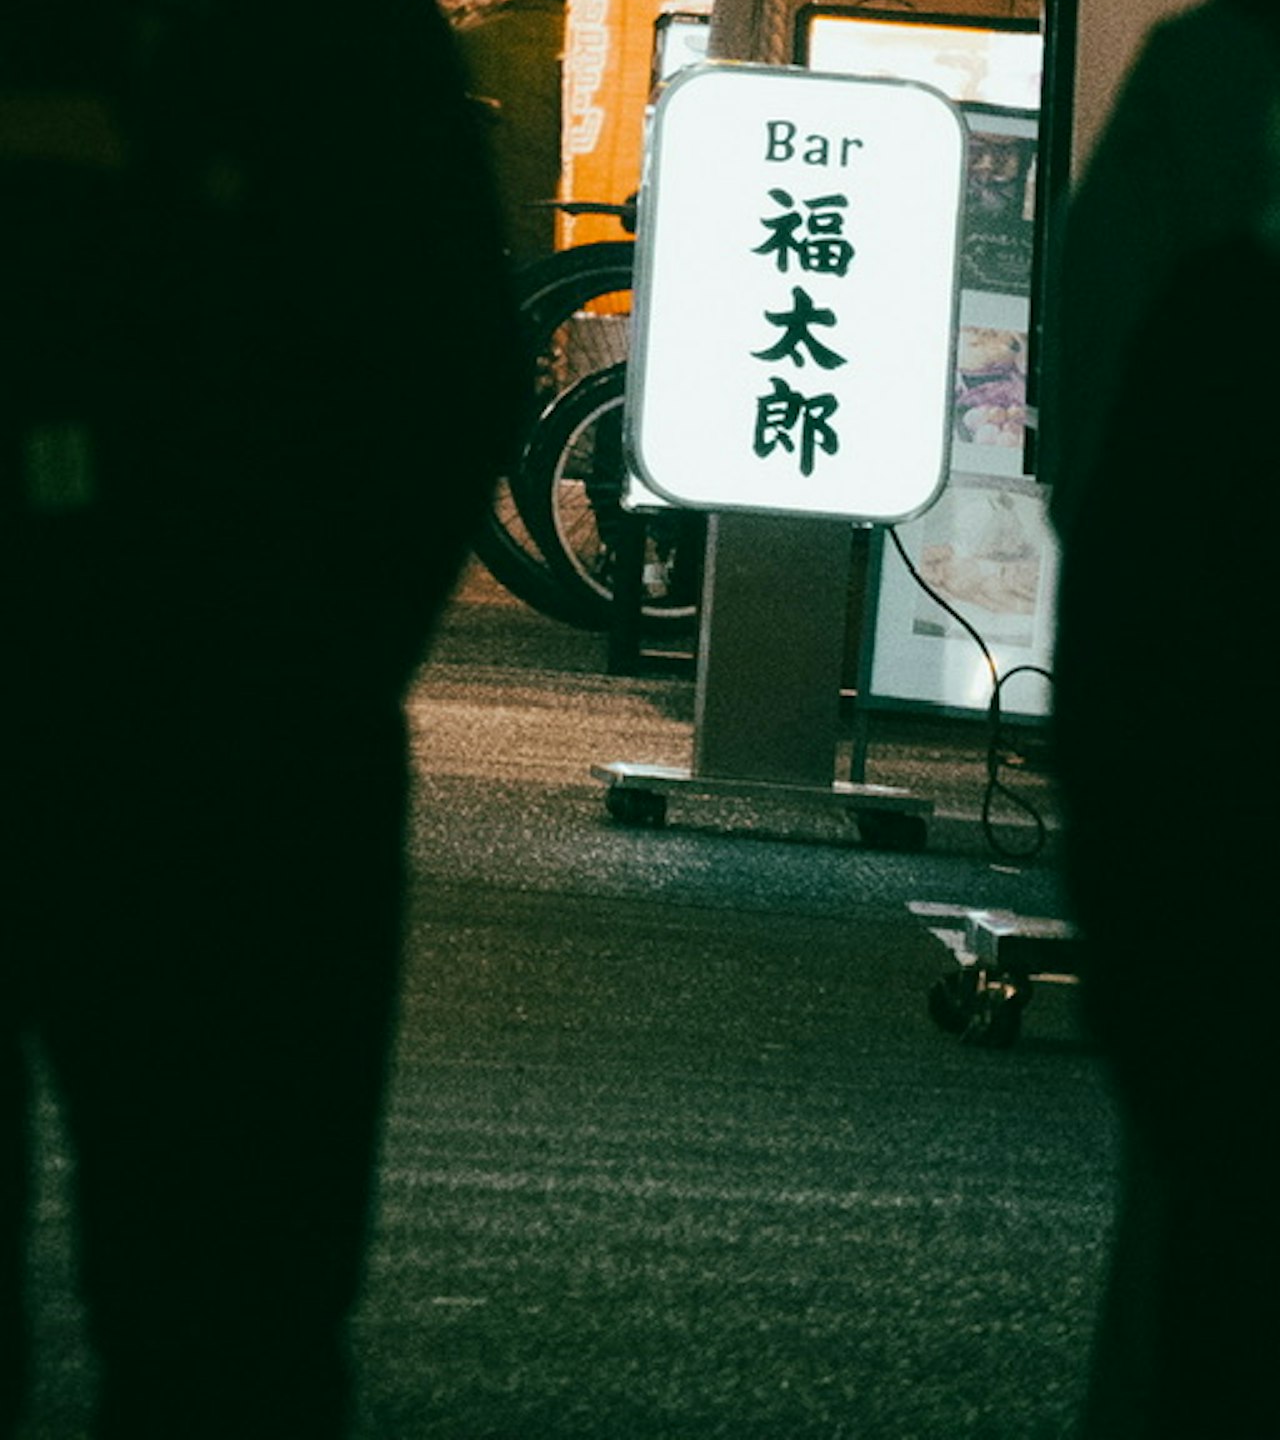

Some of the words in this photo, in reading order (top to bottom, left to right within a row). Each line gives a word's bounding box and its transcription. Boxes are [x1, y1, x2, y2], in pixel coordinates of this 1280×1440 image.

[766, 121, 864, 167] Bar
[752, 188, 856, 478] 福太郎
